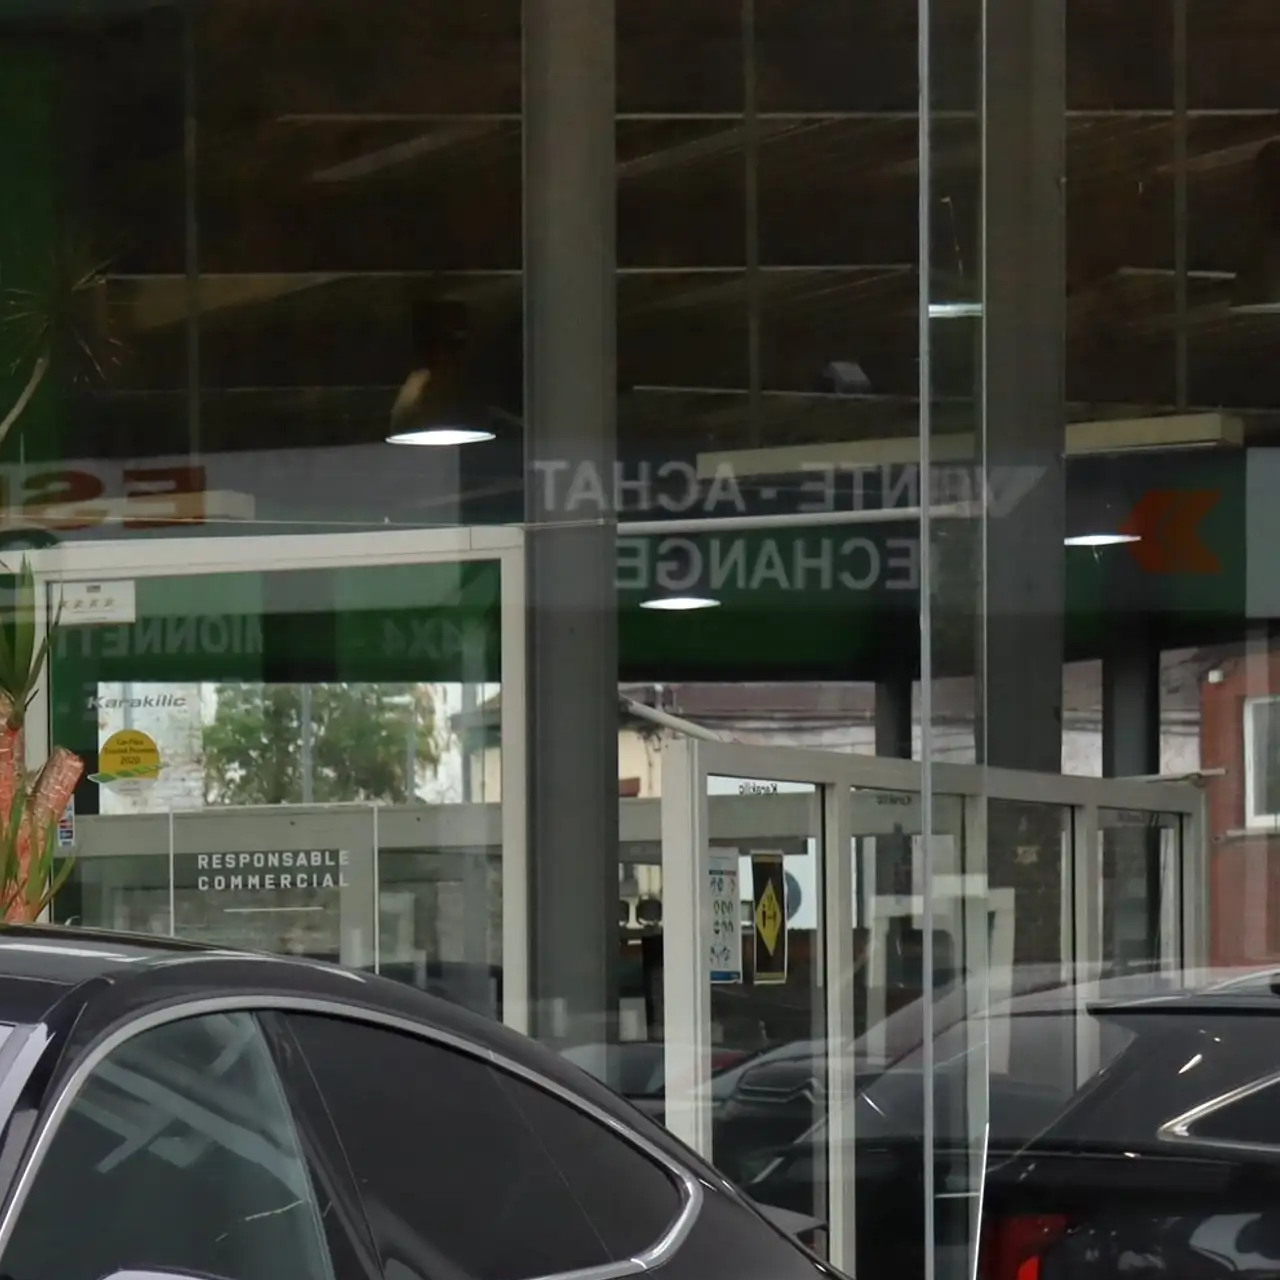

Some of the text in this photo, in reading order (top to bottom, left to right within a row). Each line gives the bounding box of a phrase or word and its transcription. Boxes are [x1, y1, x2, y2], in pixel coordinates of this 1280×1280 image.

[87, 693, 187, 710] Karakilic
[197, 850, 350, 870] RESPONSABLE
[197, 872, 350, 891] COMMERCIAL
